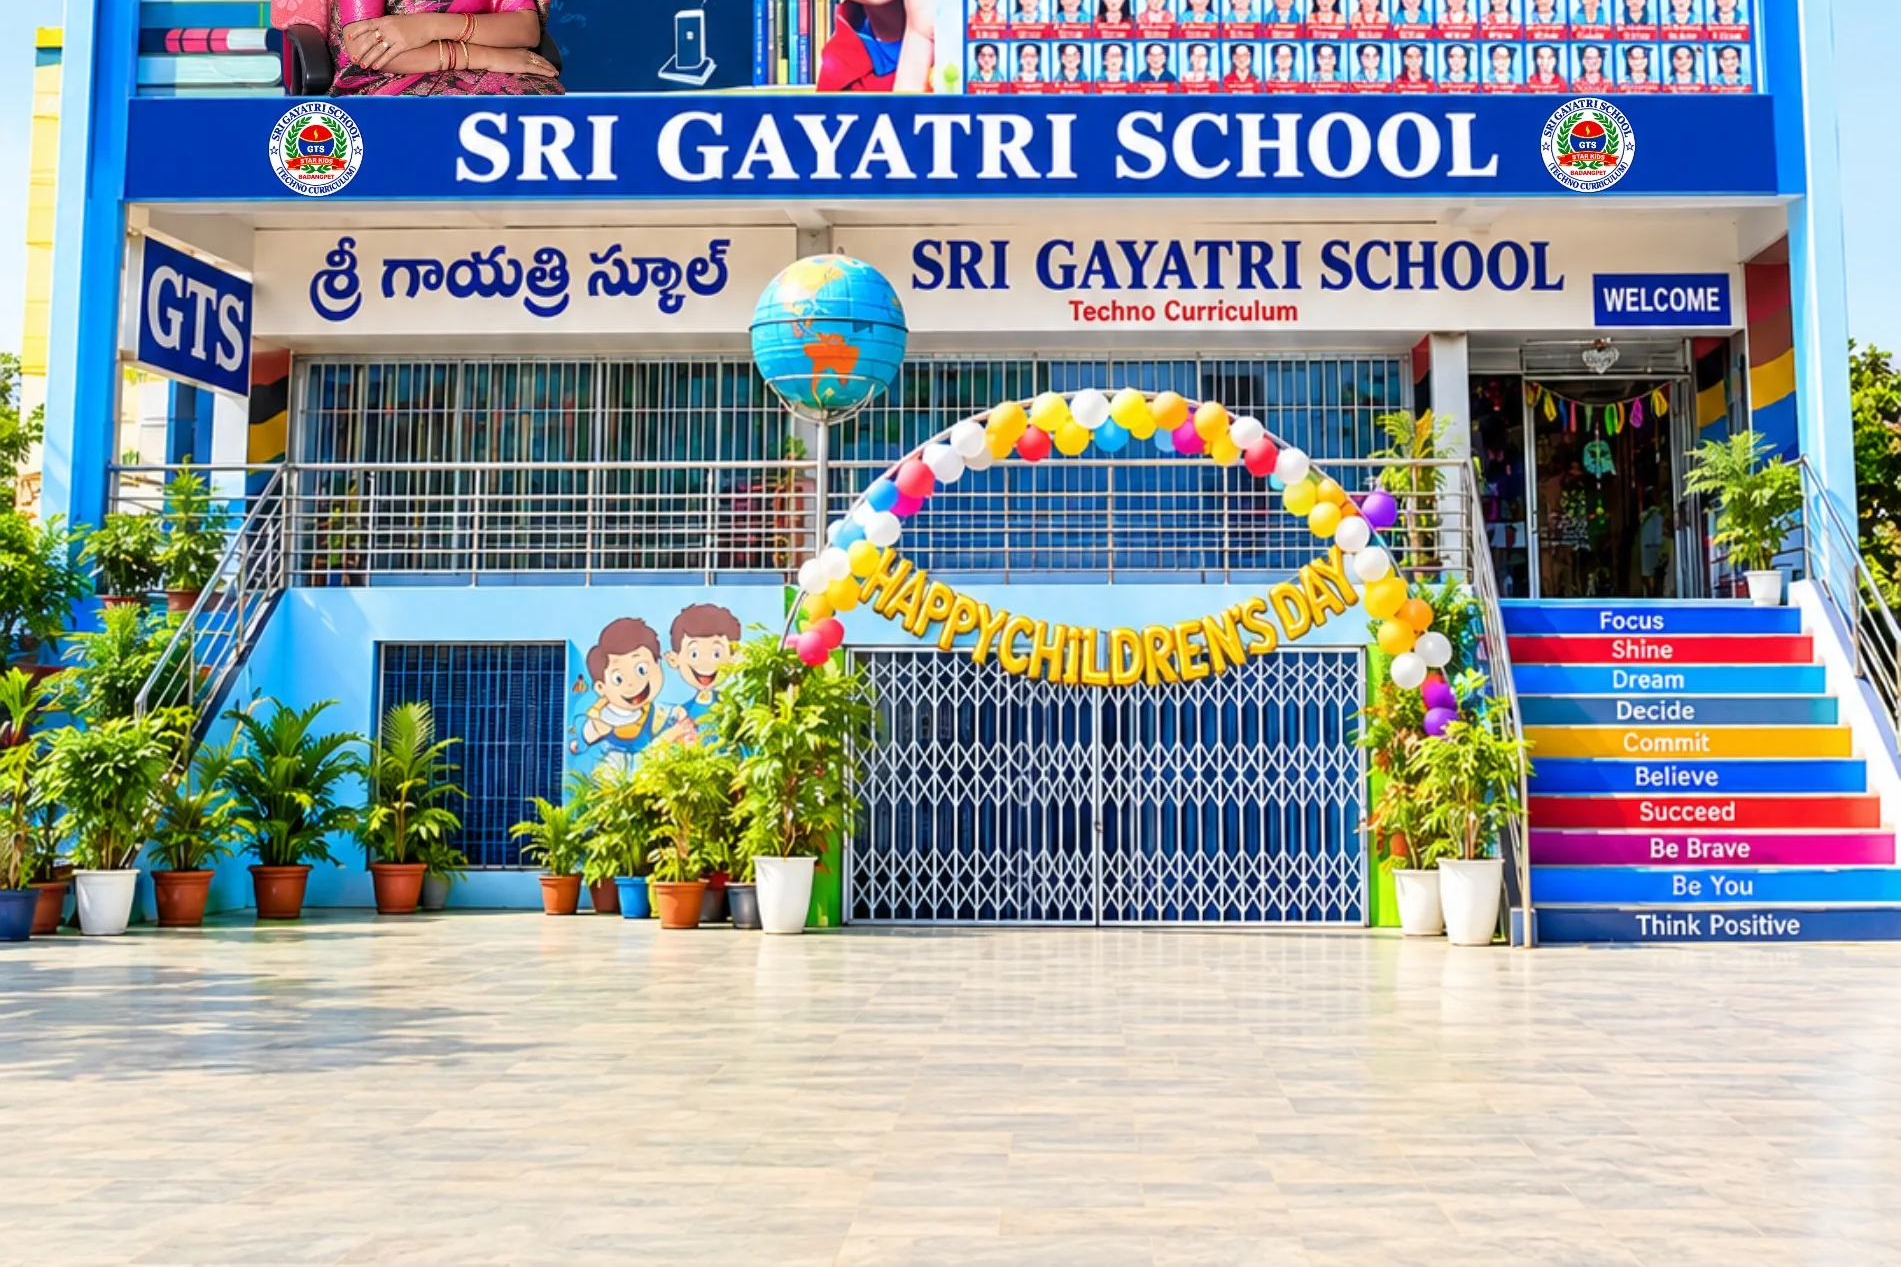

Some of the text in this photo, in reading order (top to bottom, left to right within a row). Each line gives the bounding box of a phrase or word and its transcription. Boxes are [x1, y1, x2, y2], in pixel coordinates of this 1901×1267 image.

[272, 104, 360, 141] SRI GAYATRI SCHOOL
[1544, 99, 1632, 137] SRI GAYATRI SCHOOL
[457, 112, 1497, 182] SRI GAYATRI SCHOOL
[276, 166, 356, 194] (TECHNO CURRICULUM)
[1548, 162, 1628, 190] (TECHNO CURRICULUM)
[913, 240, 1563, 290] SRI GAYATRI SCHOOL
[311, 238, 729, 321] శ్రీ గాయత్రి స్కూల్
[1604, 288, 1719, 311] WELCOME
[148, 265, 244, 372] GTS
[1069, 301, 1297, 321] Techno Curriculum
[1269, 544, 1359, 641] DAY
[1601, 612, 1663, 629] Focus
[1613, 640, 1672, 658] Shine
[1614, 671, 1683, 688] Dream
[1617, 701, 1694, 719] Decide
[1625, 734, 1708, 751] Commit
[1637, 767, 1717, 785] Believe
[1641, 802, 1734, 821] Succeed
[1651, 838, 1749, 857] Be Brave
[1674, 876, 1752, 894] Be You
[1636, 914, 1799, 935] Think Positive
